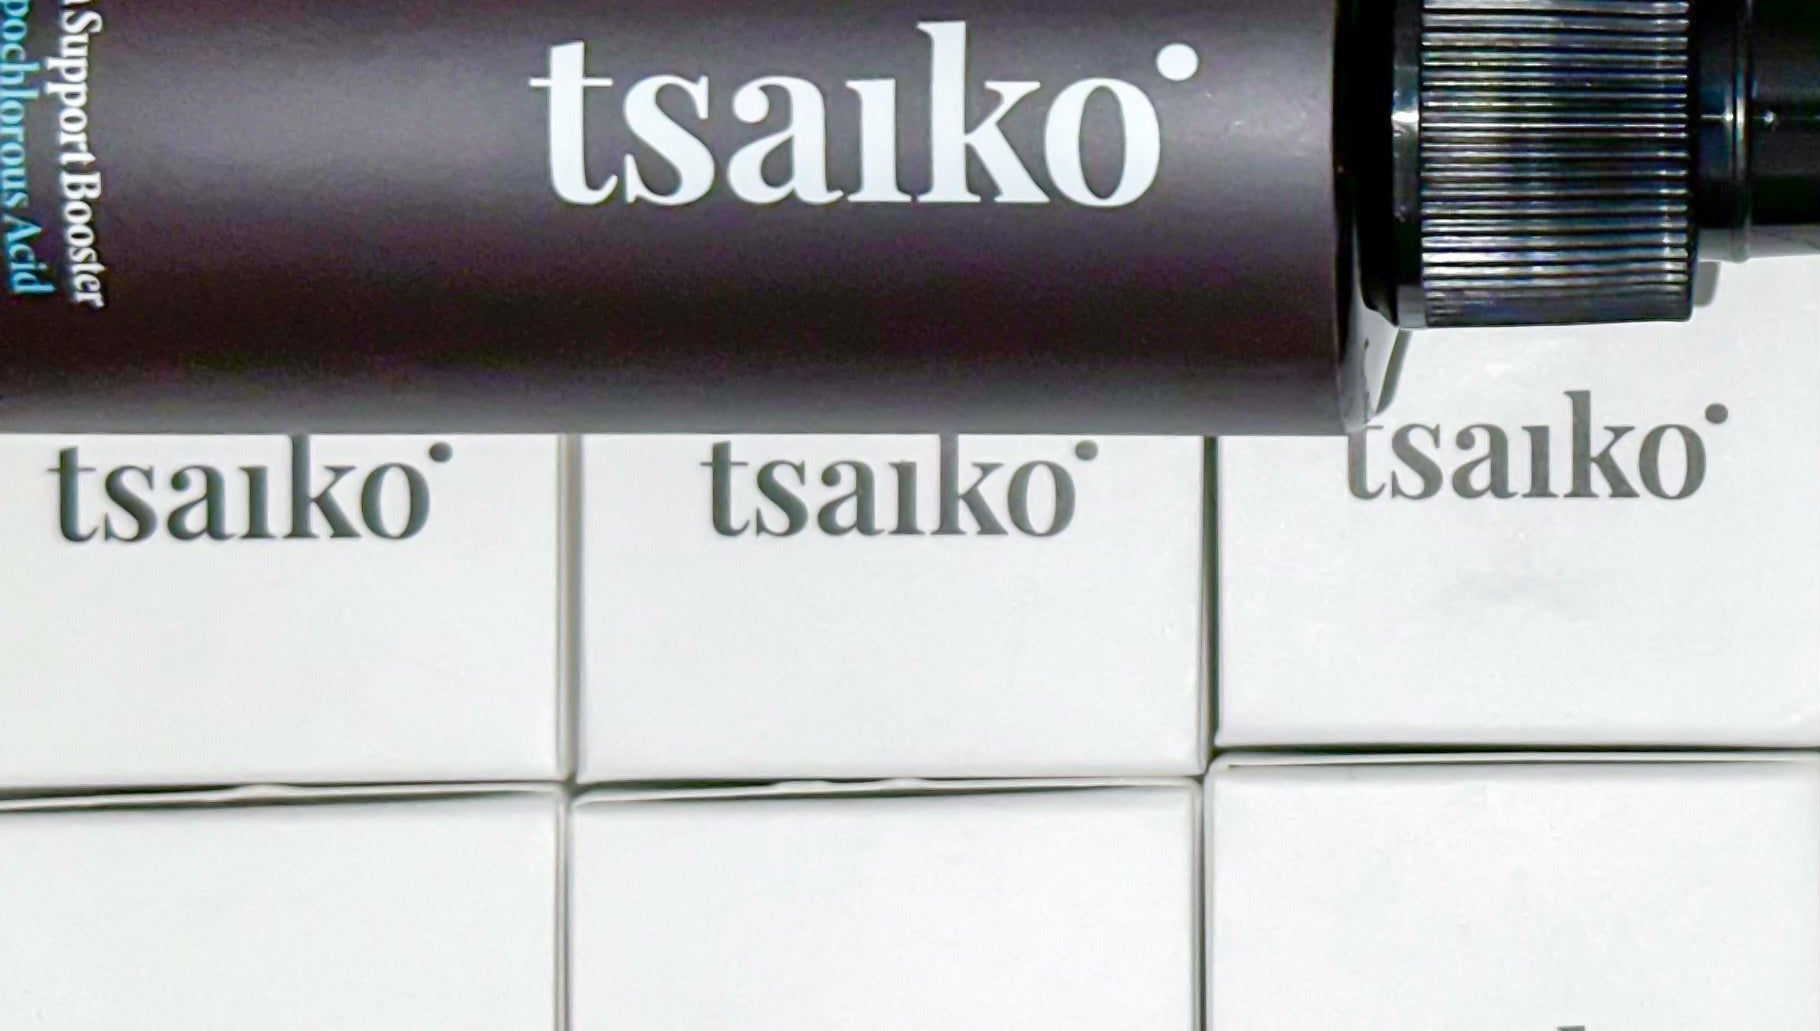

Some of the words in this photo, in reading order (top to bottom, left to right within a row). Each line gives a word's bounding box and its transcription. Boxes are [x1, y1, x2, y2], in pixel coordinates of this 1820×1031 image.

[45, 10, 103, 166] Support
[3, 210, 56, 294] Acid
[60, 171, 106, 308] Booster
